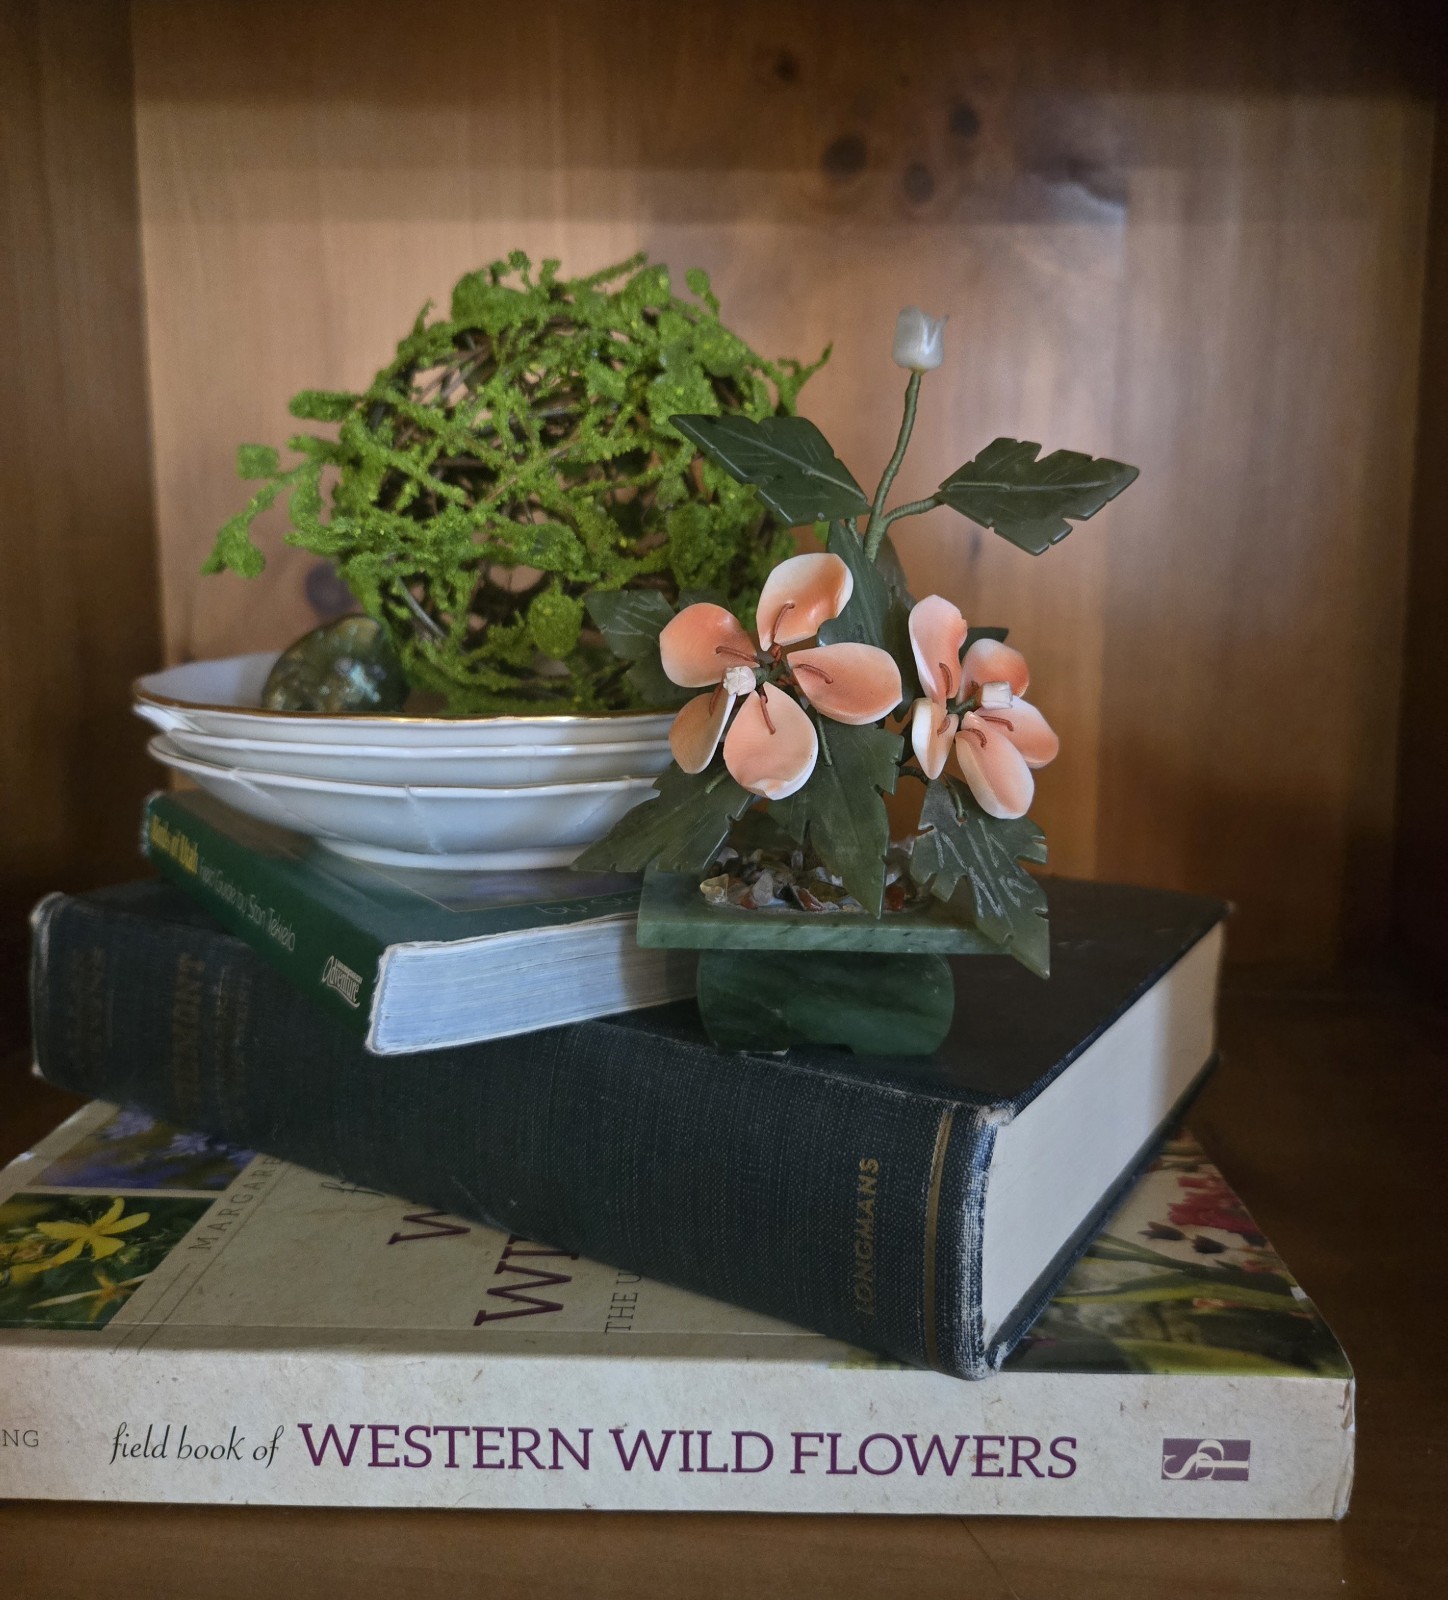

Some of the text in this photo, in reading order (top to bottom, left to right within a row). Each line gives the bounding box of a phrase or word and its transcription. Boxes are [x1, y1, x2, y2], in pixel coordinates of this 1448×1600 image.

[187, 1157, 282, 1250] MARGARE
[853, 1157, 881, 1317] LONGMANS
[604, 1291, 639, 1334] THE
[109, 1421, 168, 1465] field
[176, 1425, 244, 1462] book
[251, 1424, 286, 1468] of
[298, 1422, 595, 1472] WESTERN
[608, 1428, 775, 1474] WILD
[790, 1431, 1078, 1479] FLOWERS
